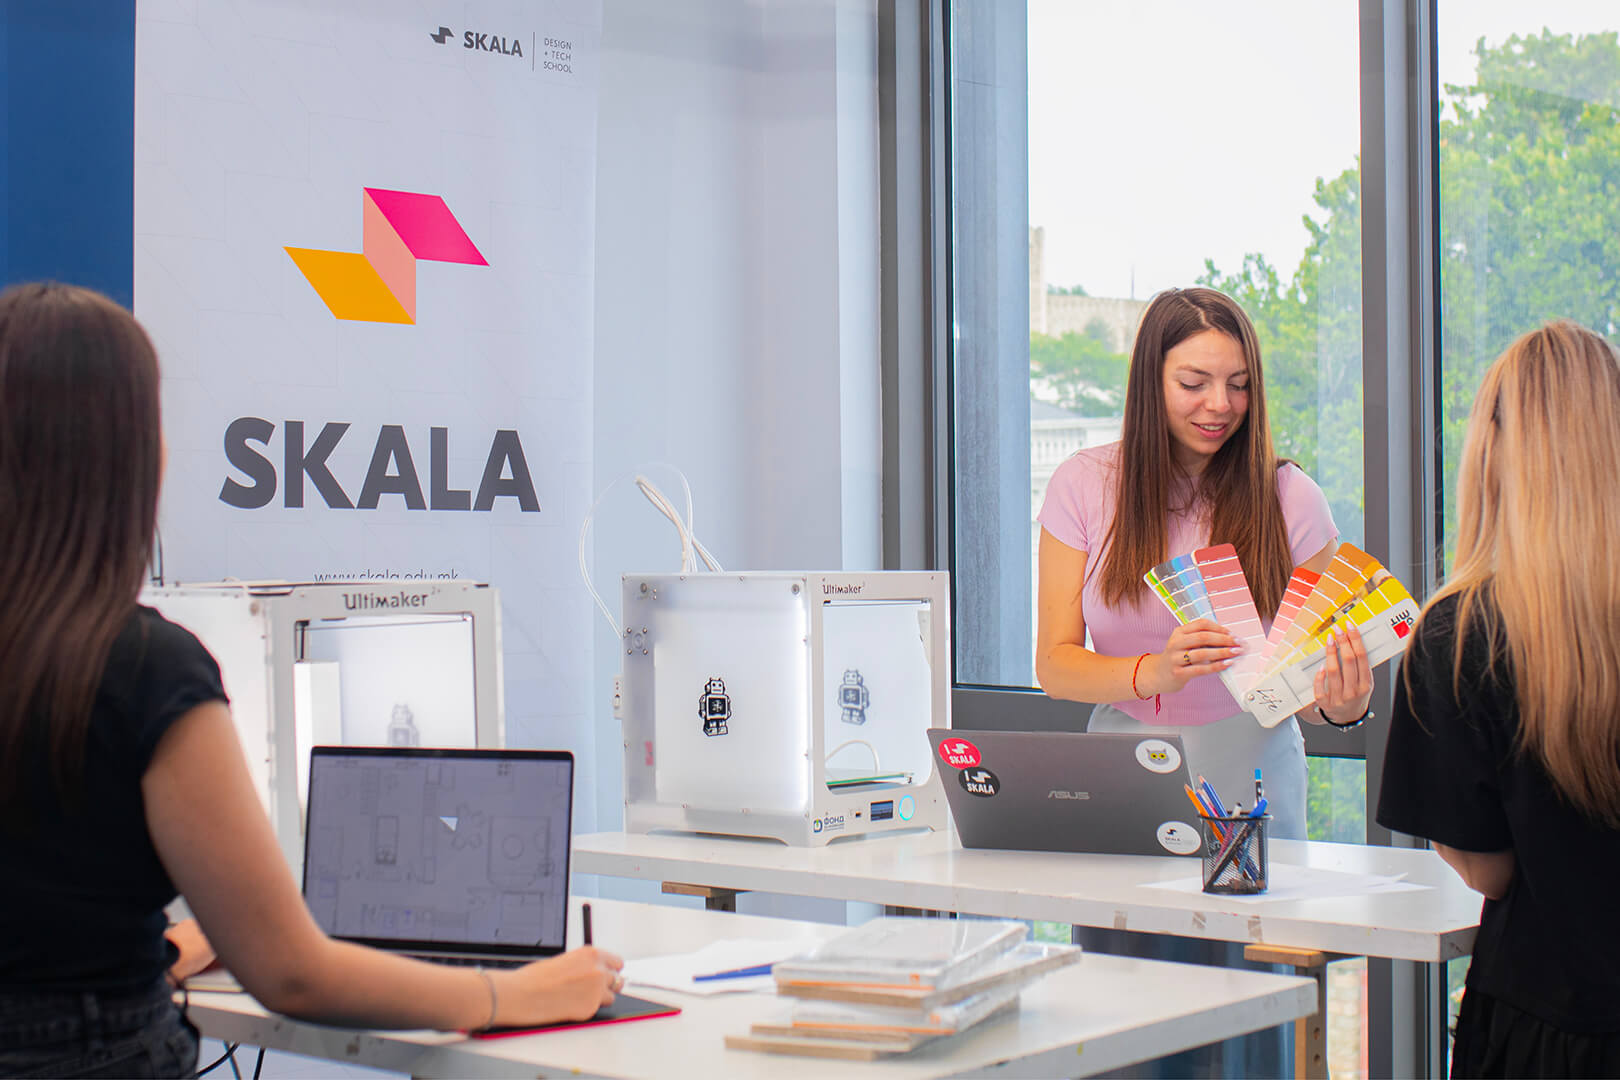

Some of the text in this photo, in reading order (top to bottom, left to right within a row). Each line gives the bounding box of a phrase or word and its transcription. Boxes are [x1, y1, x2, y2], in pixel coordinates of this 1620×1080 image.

[463, 31, 523, 57] SKALA
[544, 38, 572, 50] DESIGN
[552, 50, 571, 61] TECH
[543, 61, 573, 73] SCHOOL
[218, 416, 542, 513] SKALA
[342, 591, 428, 610] Ultimaker
[949, 754, 976, 765] SKALA
[967, 782, 995, 795] SKALA
[1048, 790, 1090, 800] ASUS
